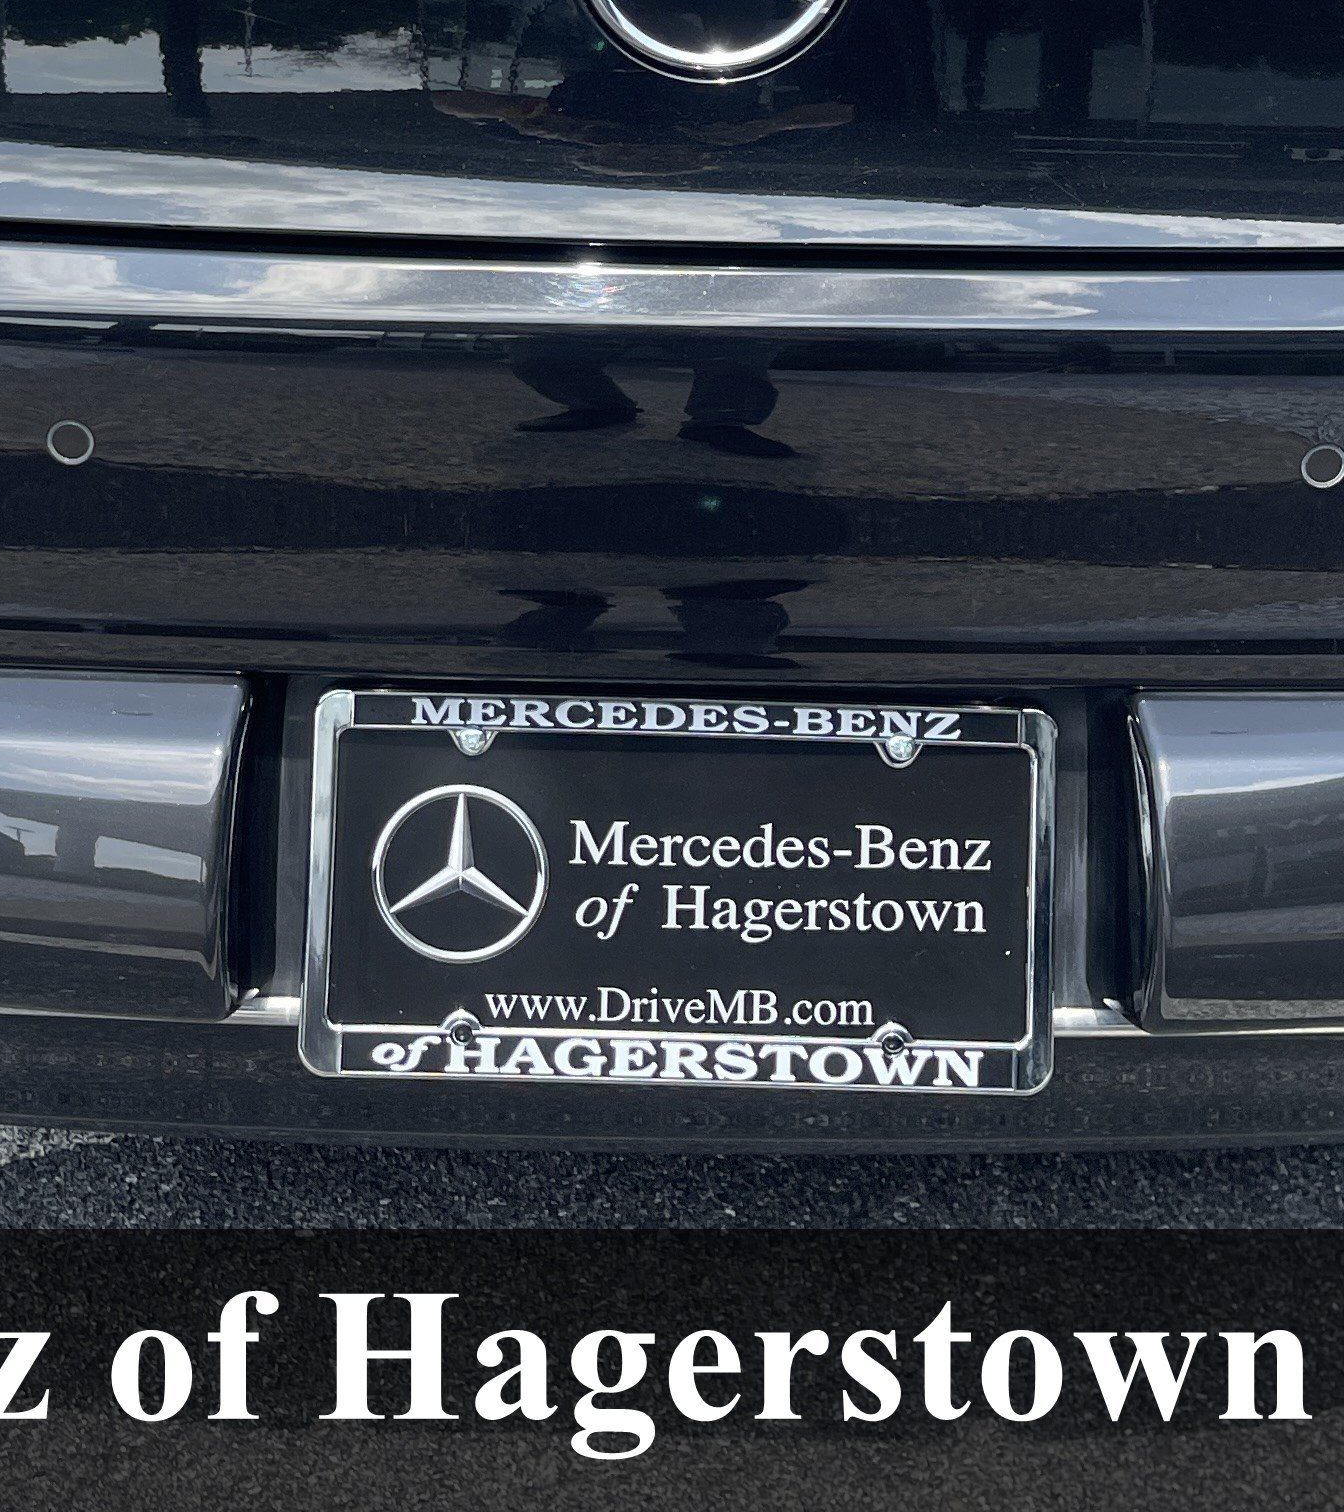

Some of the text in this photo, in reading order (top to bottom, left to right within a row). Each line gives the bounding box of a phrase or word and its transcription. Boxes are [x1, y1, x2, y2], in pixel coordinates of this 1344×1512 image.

[410, 695, 963, 741] MERCEDES-BENZ
[568, 819, 993, 872] Mercedes-Benz
[575, 883, 988, 944] of Hagerstown
[483, 987, 877, 1028] www.DriveMB.com
[370, 1035, 985, 1089] of HAGERSTOWN
